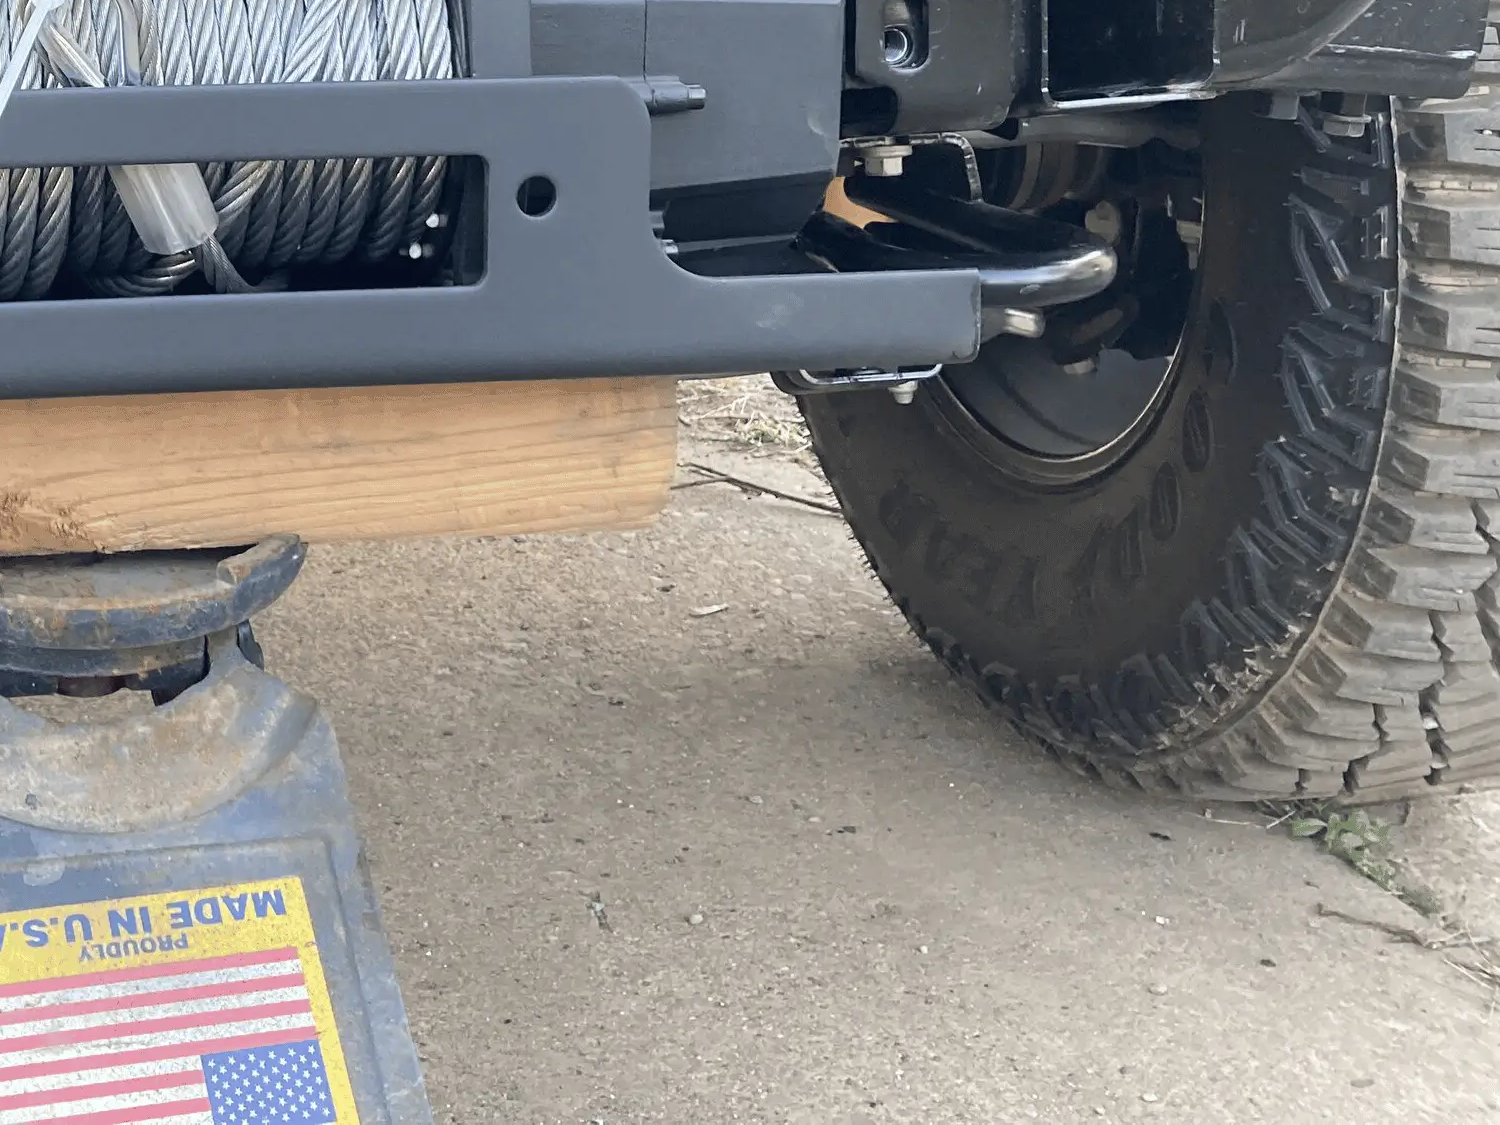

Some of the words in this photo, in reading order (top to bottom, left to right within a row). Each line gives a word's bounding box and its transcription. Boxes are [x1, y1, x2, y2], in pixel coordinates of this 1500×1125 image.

[107, 905, 152, 938] IN
[166, 888, 287, 930] MADE
[79, 932, 190, 963] PROUDLY
